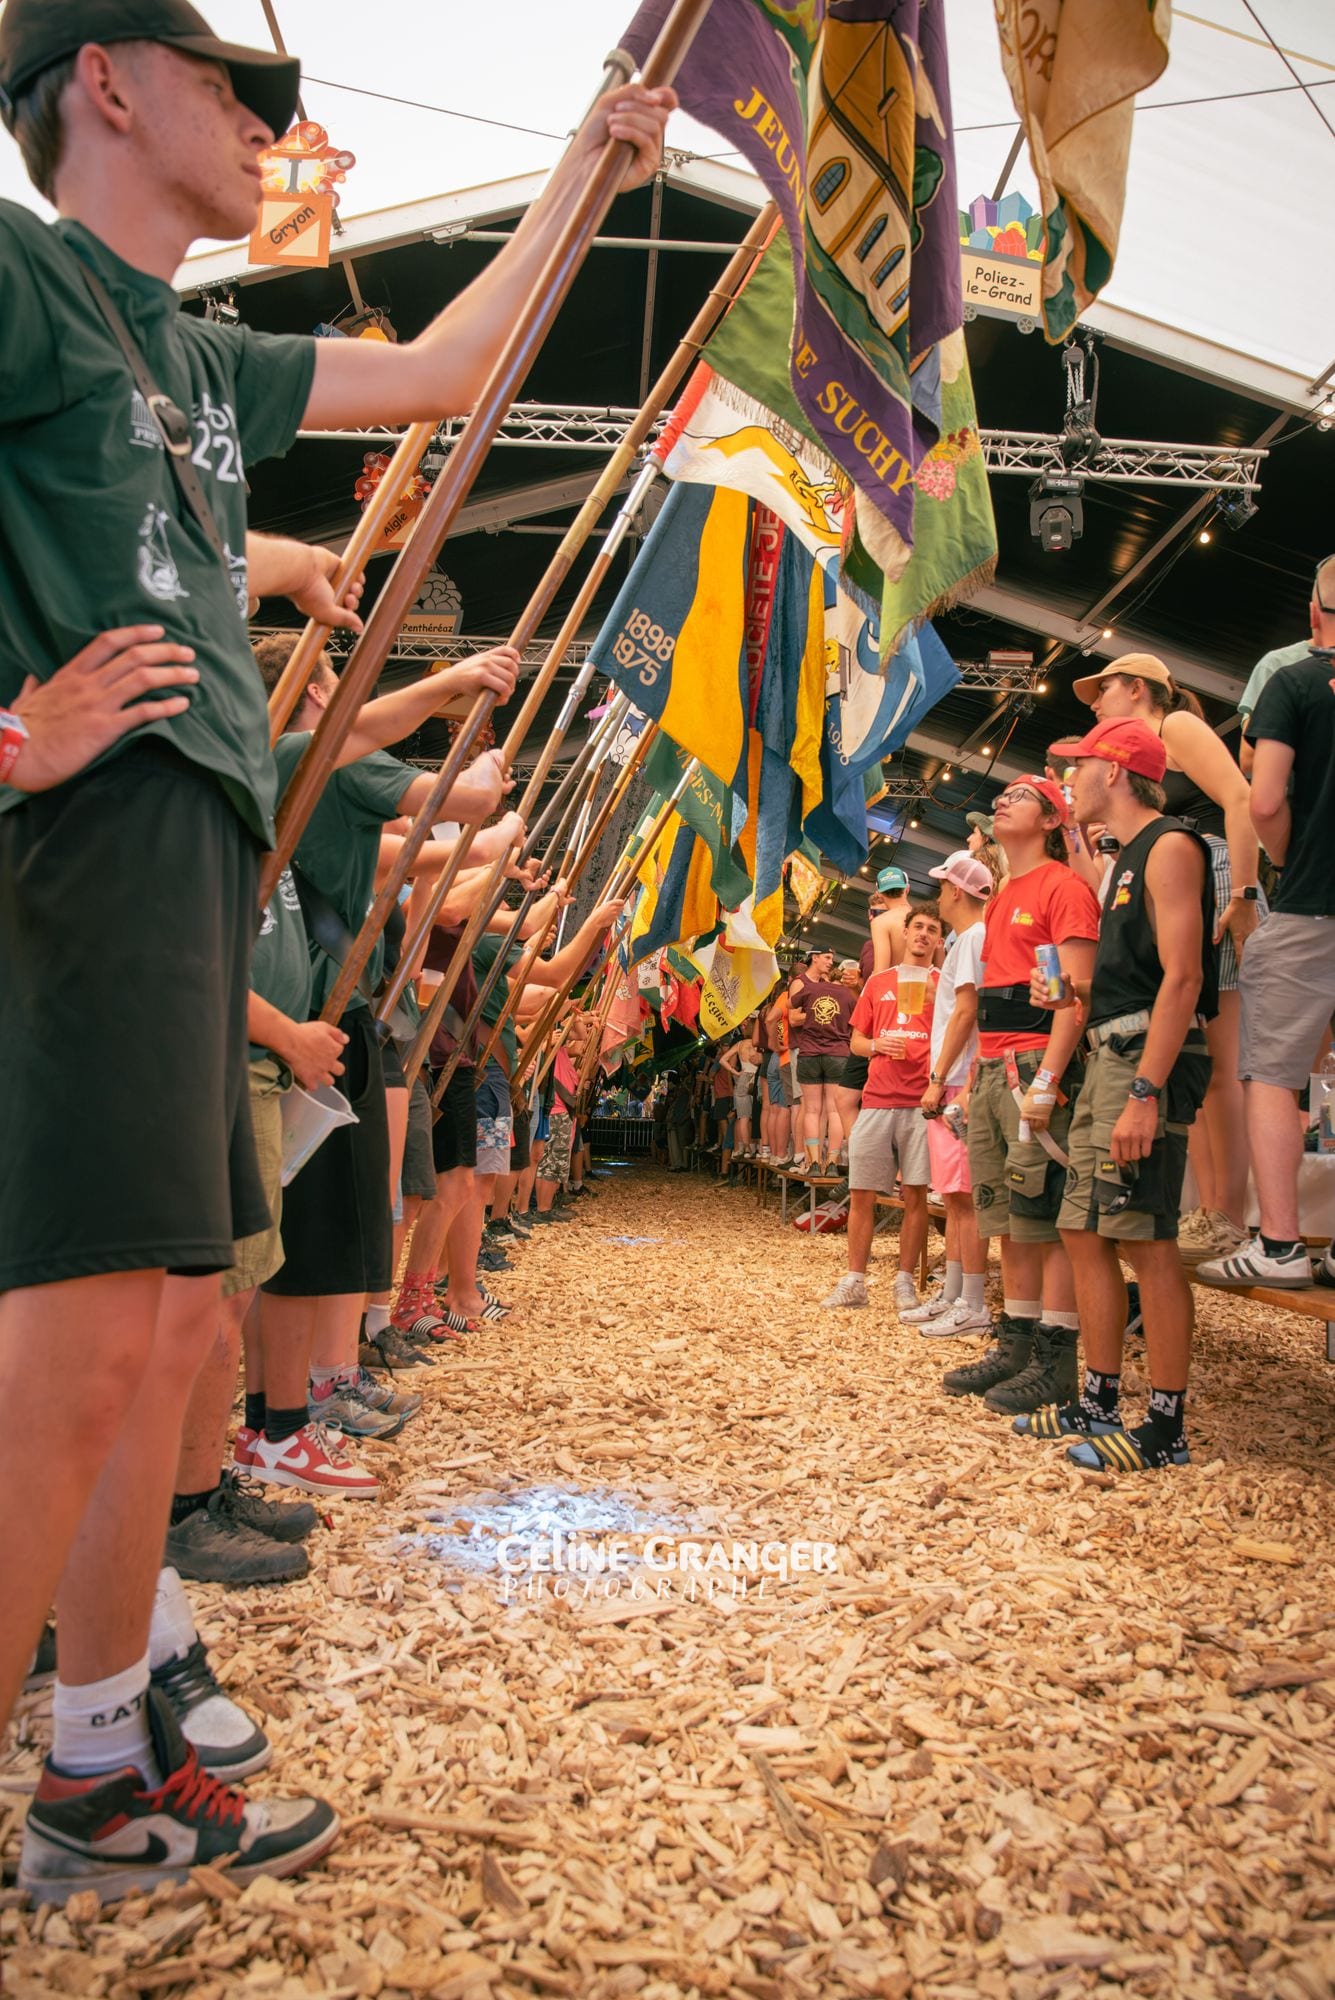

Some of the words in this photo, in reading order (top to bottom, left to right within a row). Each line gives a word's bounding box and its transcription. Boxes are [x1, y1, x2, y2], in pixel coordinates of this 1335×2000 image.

[733, 86, 805, 226] JEUN
[269, 206, 316, 245] Gryon
[966, 280, 1033, 306] le-Grand
[975, 266, 1025, 288] Poliez-
[815, 381, 915, 496] SUCHY
[383, 511, 408, 538] Aigle
[755, 503, 781, 552] JE
[402, 623, 454, 634] Penthéréaz
[624, 607, 676, 662] 1898
[612, 631, 662, 686] 1975
